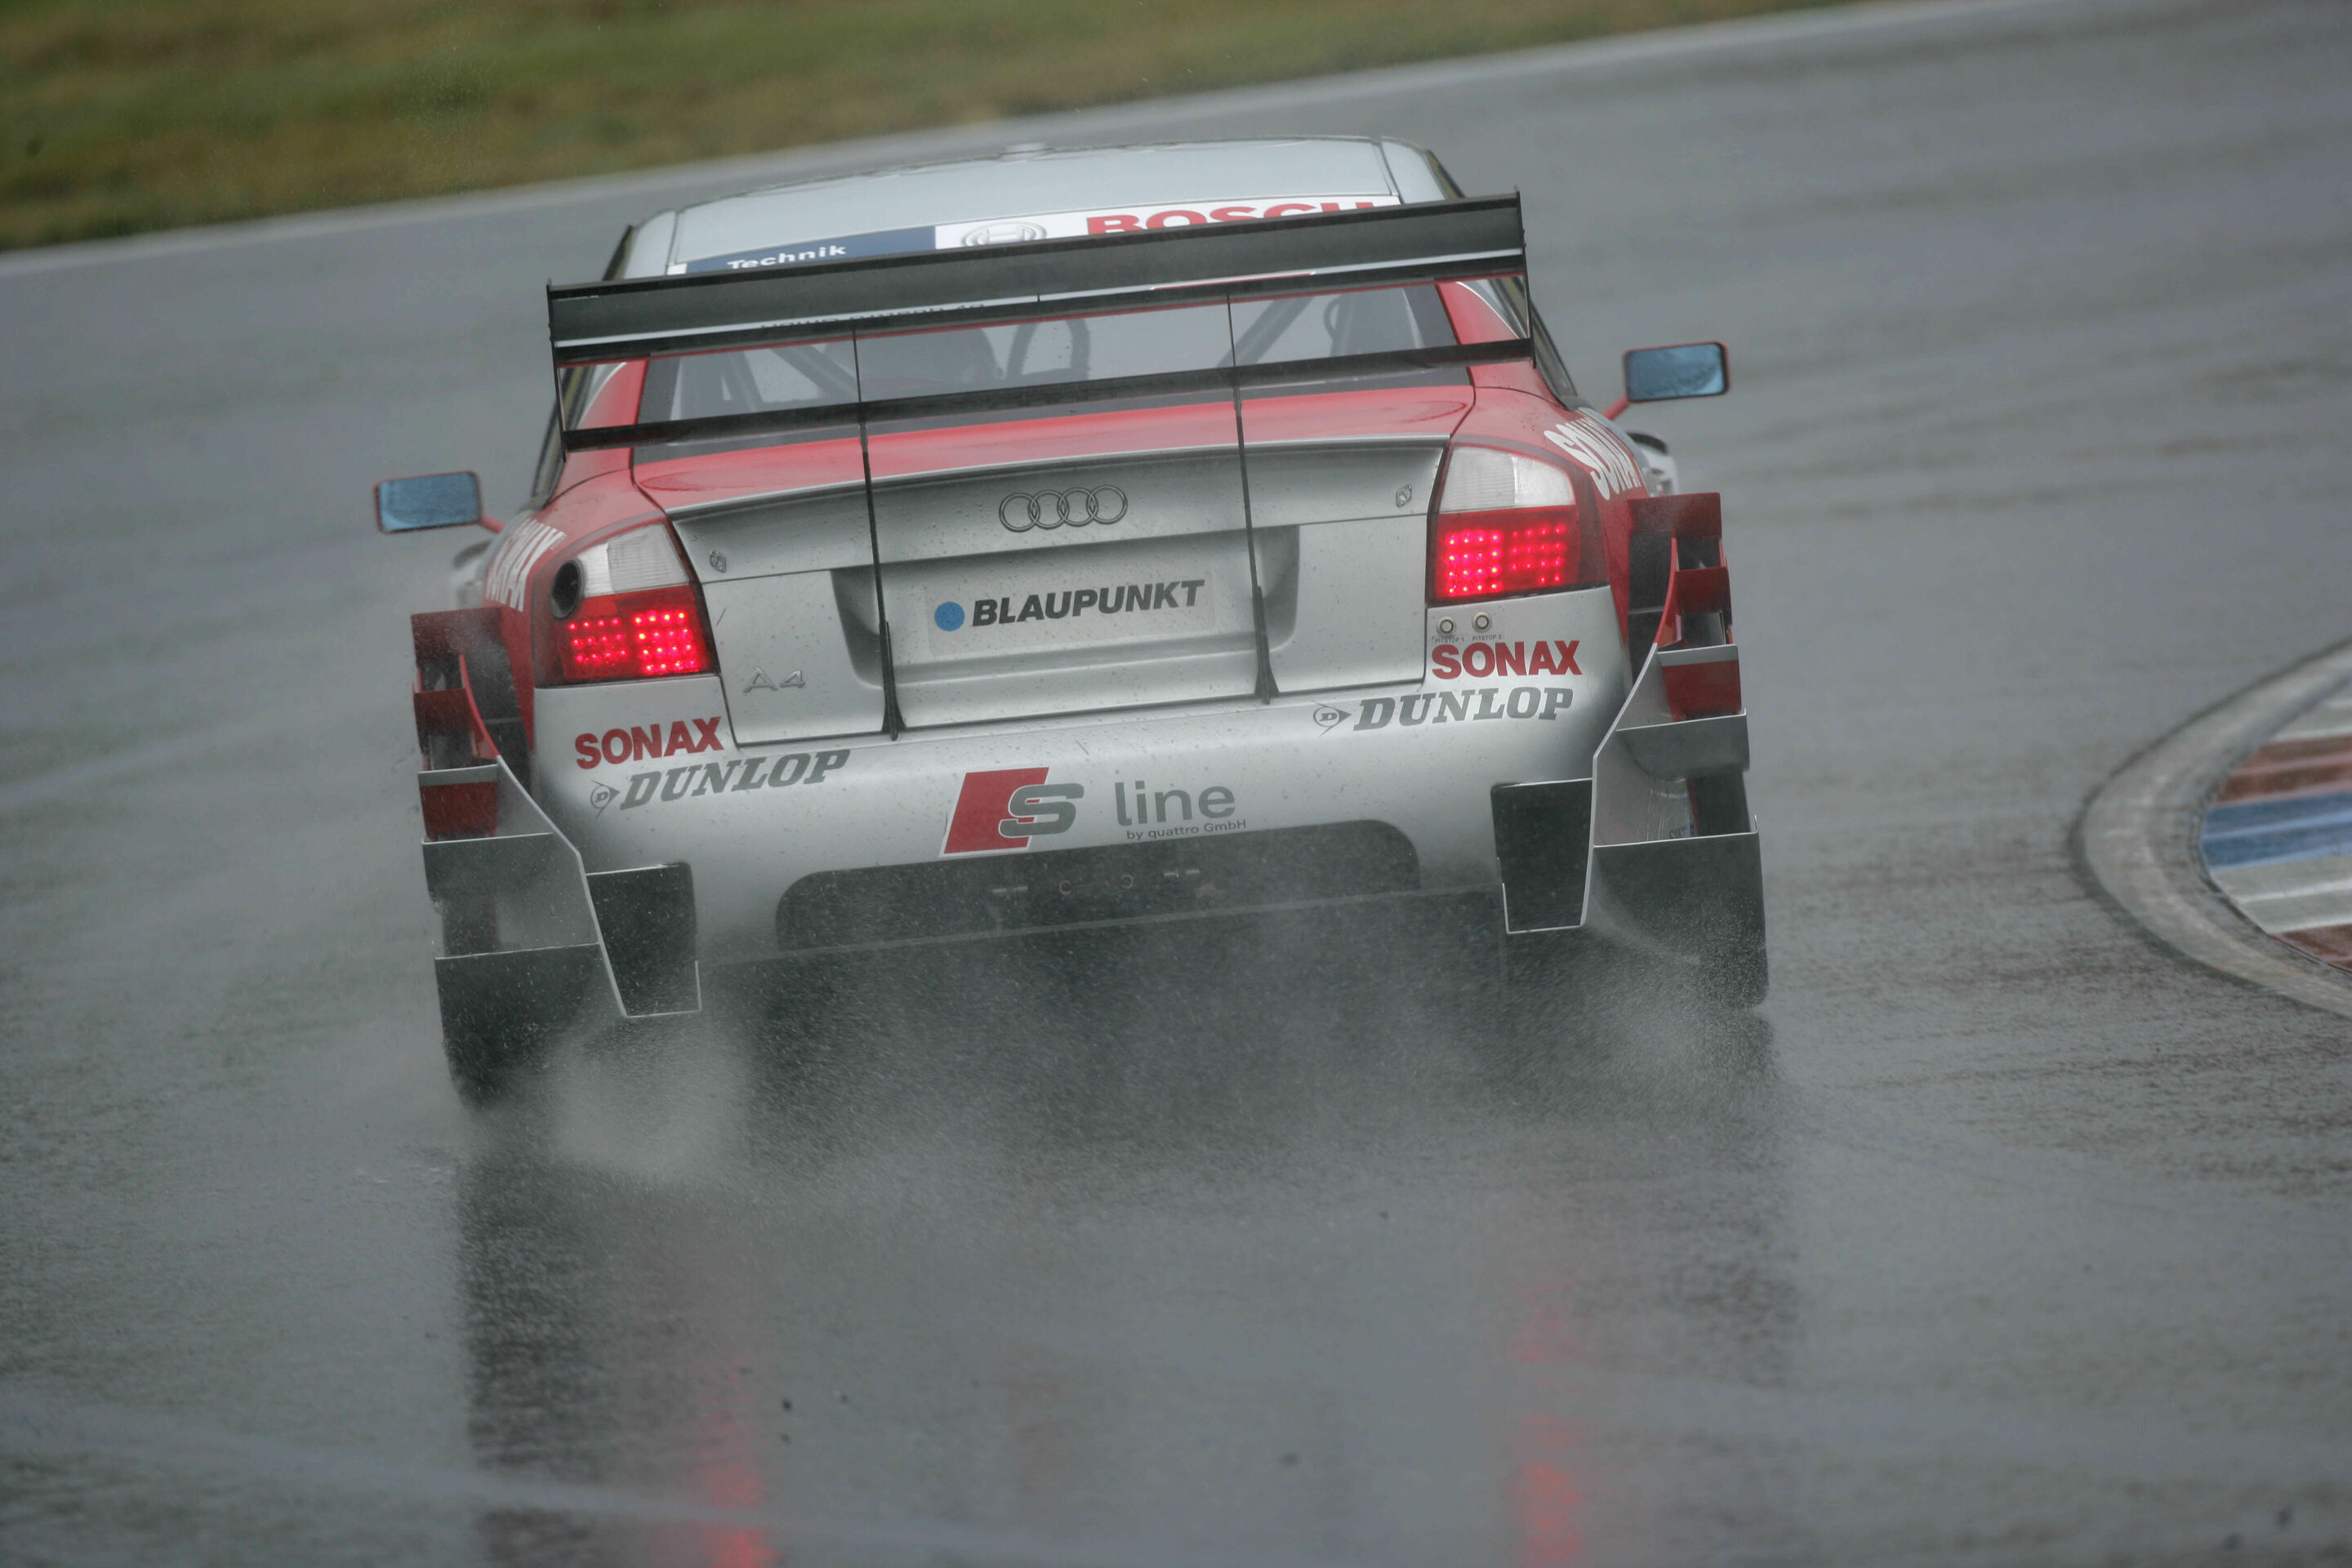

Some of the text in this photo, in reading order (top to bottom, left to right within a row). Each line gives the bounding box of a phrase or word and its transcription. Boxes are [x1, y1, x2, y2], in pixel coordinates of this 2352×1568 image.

[726, 245, 847, 270] Technik
[972, 579, 1205, 627] BLAUPUNKT
[742, 666, 806, 693] A4
[1432, 640, 1582, 679] SONAX
[1352, 686, 1574, 732] DUNLOP
[574, 716, 724, 769] SONAX
[619, 750, 851, 811] DUNLOP
[999, 780, 1236, 838] S line
[1126, 819, 1246, 841] by quattro GmbH
